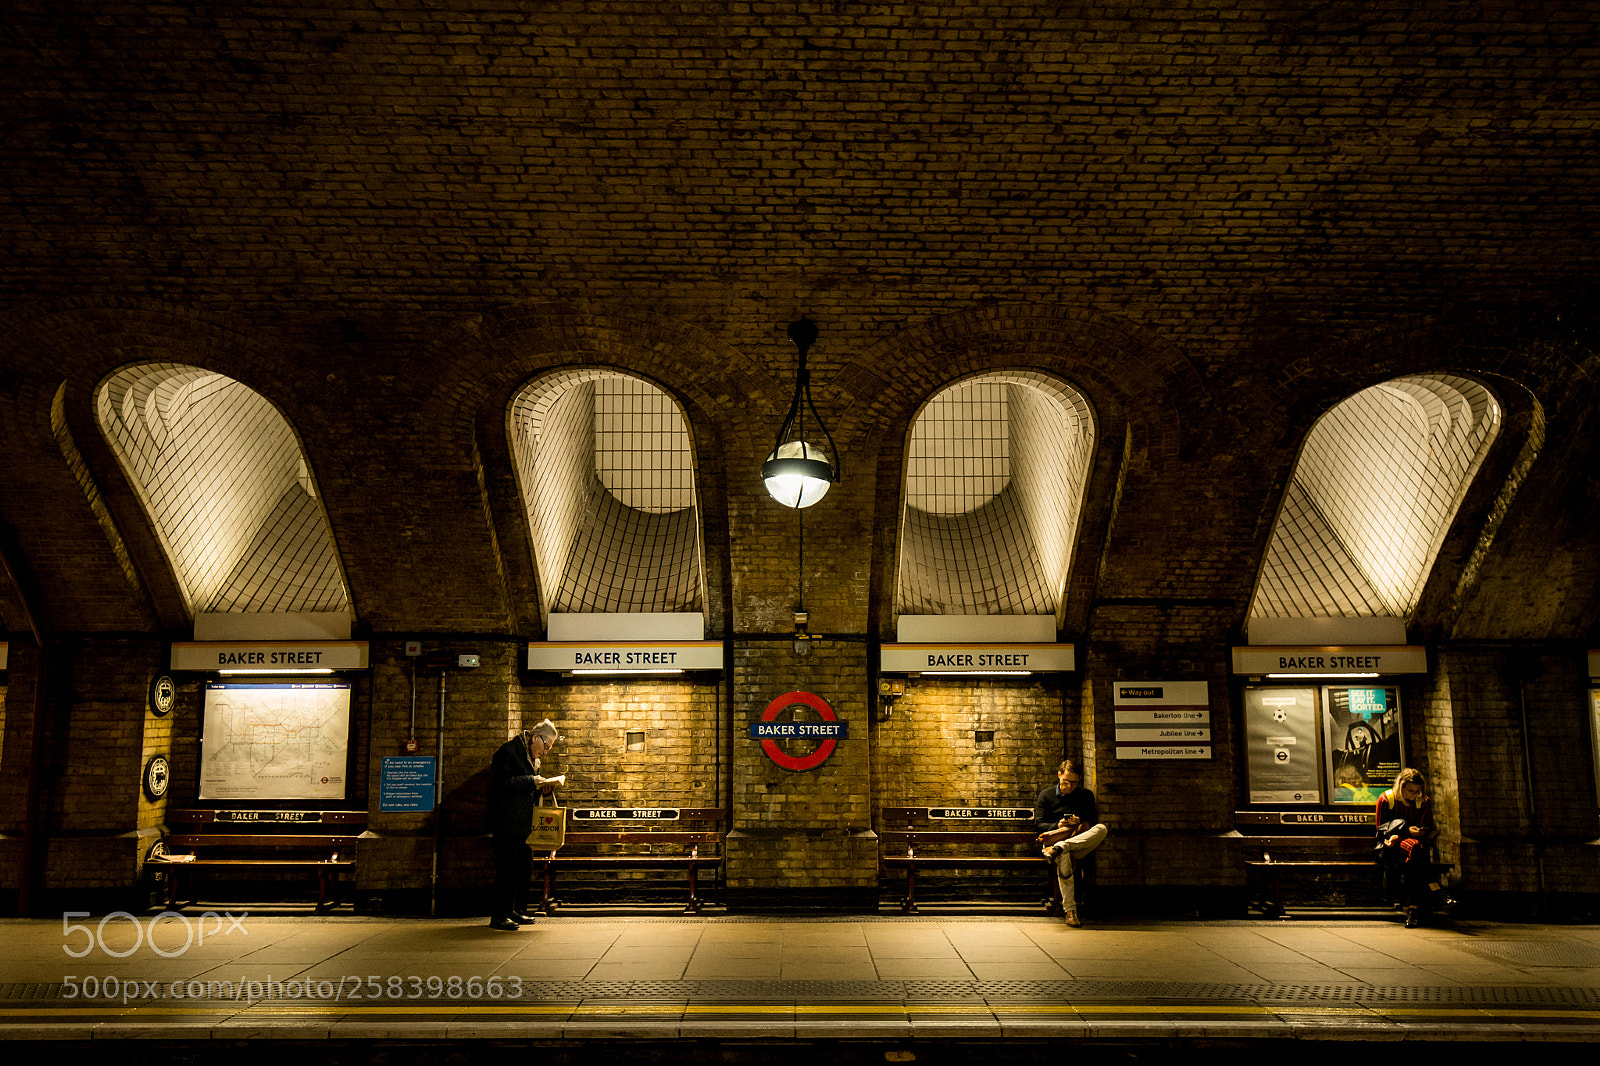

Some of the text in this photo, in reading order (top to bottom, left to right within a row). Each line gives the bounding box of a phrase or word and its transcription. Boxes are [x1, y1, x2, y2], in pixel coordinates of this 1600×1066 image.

[219, 652, 323, 664] BAKER STREET
[575, 652, 677, 664] BAKER STREET
[928, 654, 1029, 666] BAKER STREET
[1279, 656, 1381, 668] BAKER STREET
[1351, 703, 1385, 711] SORTED.
[758, 725, 840, 735] BAKER STREET
[231, 812, 305, 820] BAKER STREET
[589, 810, 662, 818] BAKER STREET
[944, 809, 1017, 818] BAKER STREET
[1296, 814, 1368, 822] BAKER STREET
[539, 816, 544, 825] I
